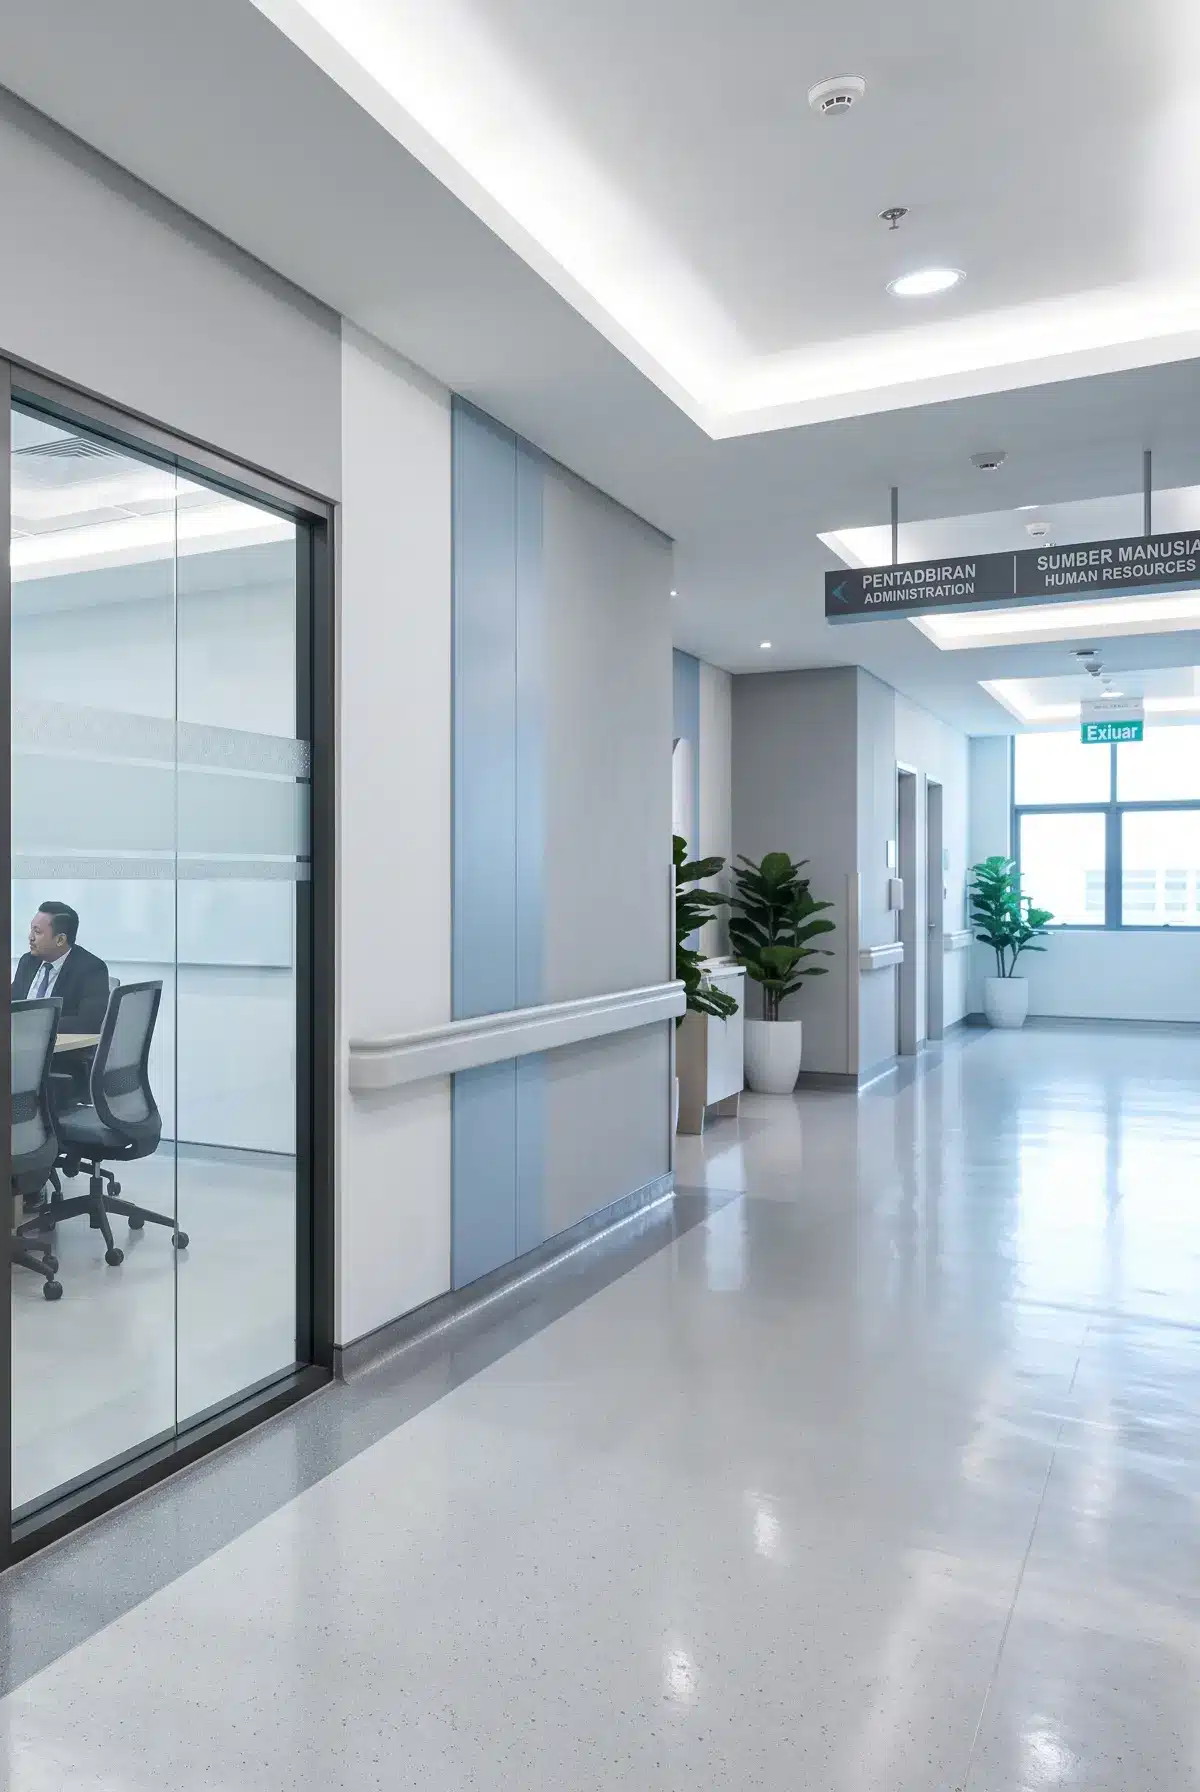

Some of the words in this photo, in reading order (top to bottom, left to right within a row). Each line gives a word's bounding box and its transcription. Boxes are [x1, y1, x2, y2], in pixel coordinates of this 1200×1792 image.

[1037, 548, 1113, 572] SUMBER
[1118, 539, 1200, 562] MANUSIA
[862, 563, 976, 589] PENTADBIRAN
[1045, 569, 1098, 587] HUMAN
[1102, 559, 1196, 581] RESOURCES
[864, 582, 975, 604] ADMINISTRATION
